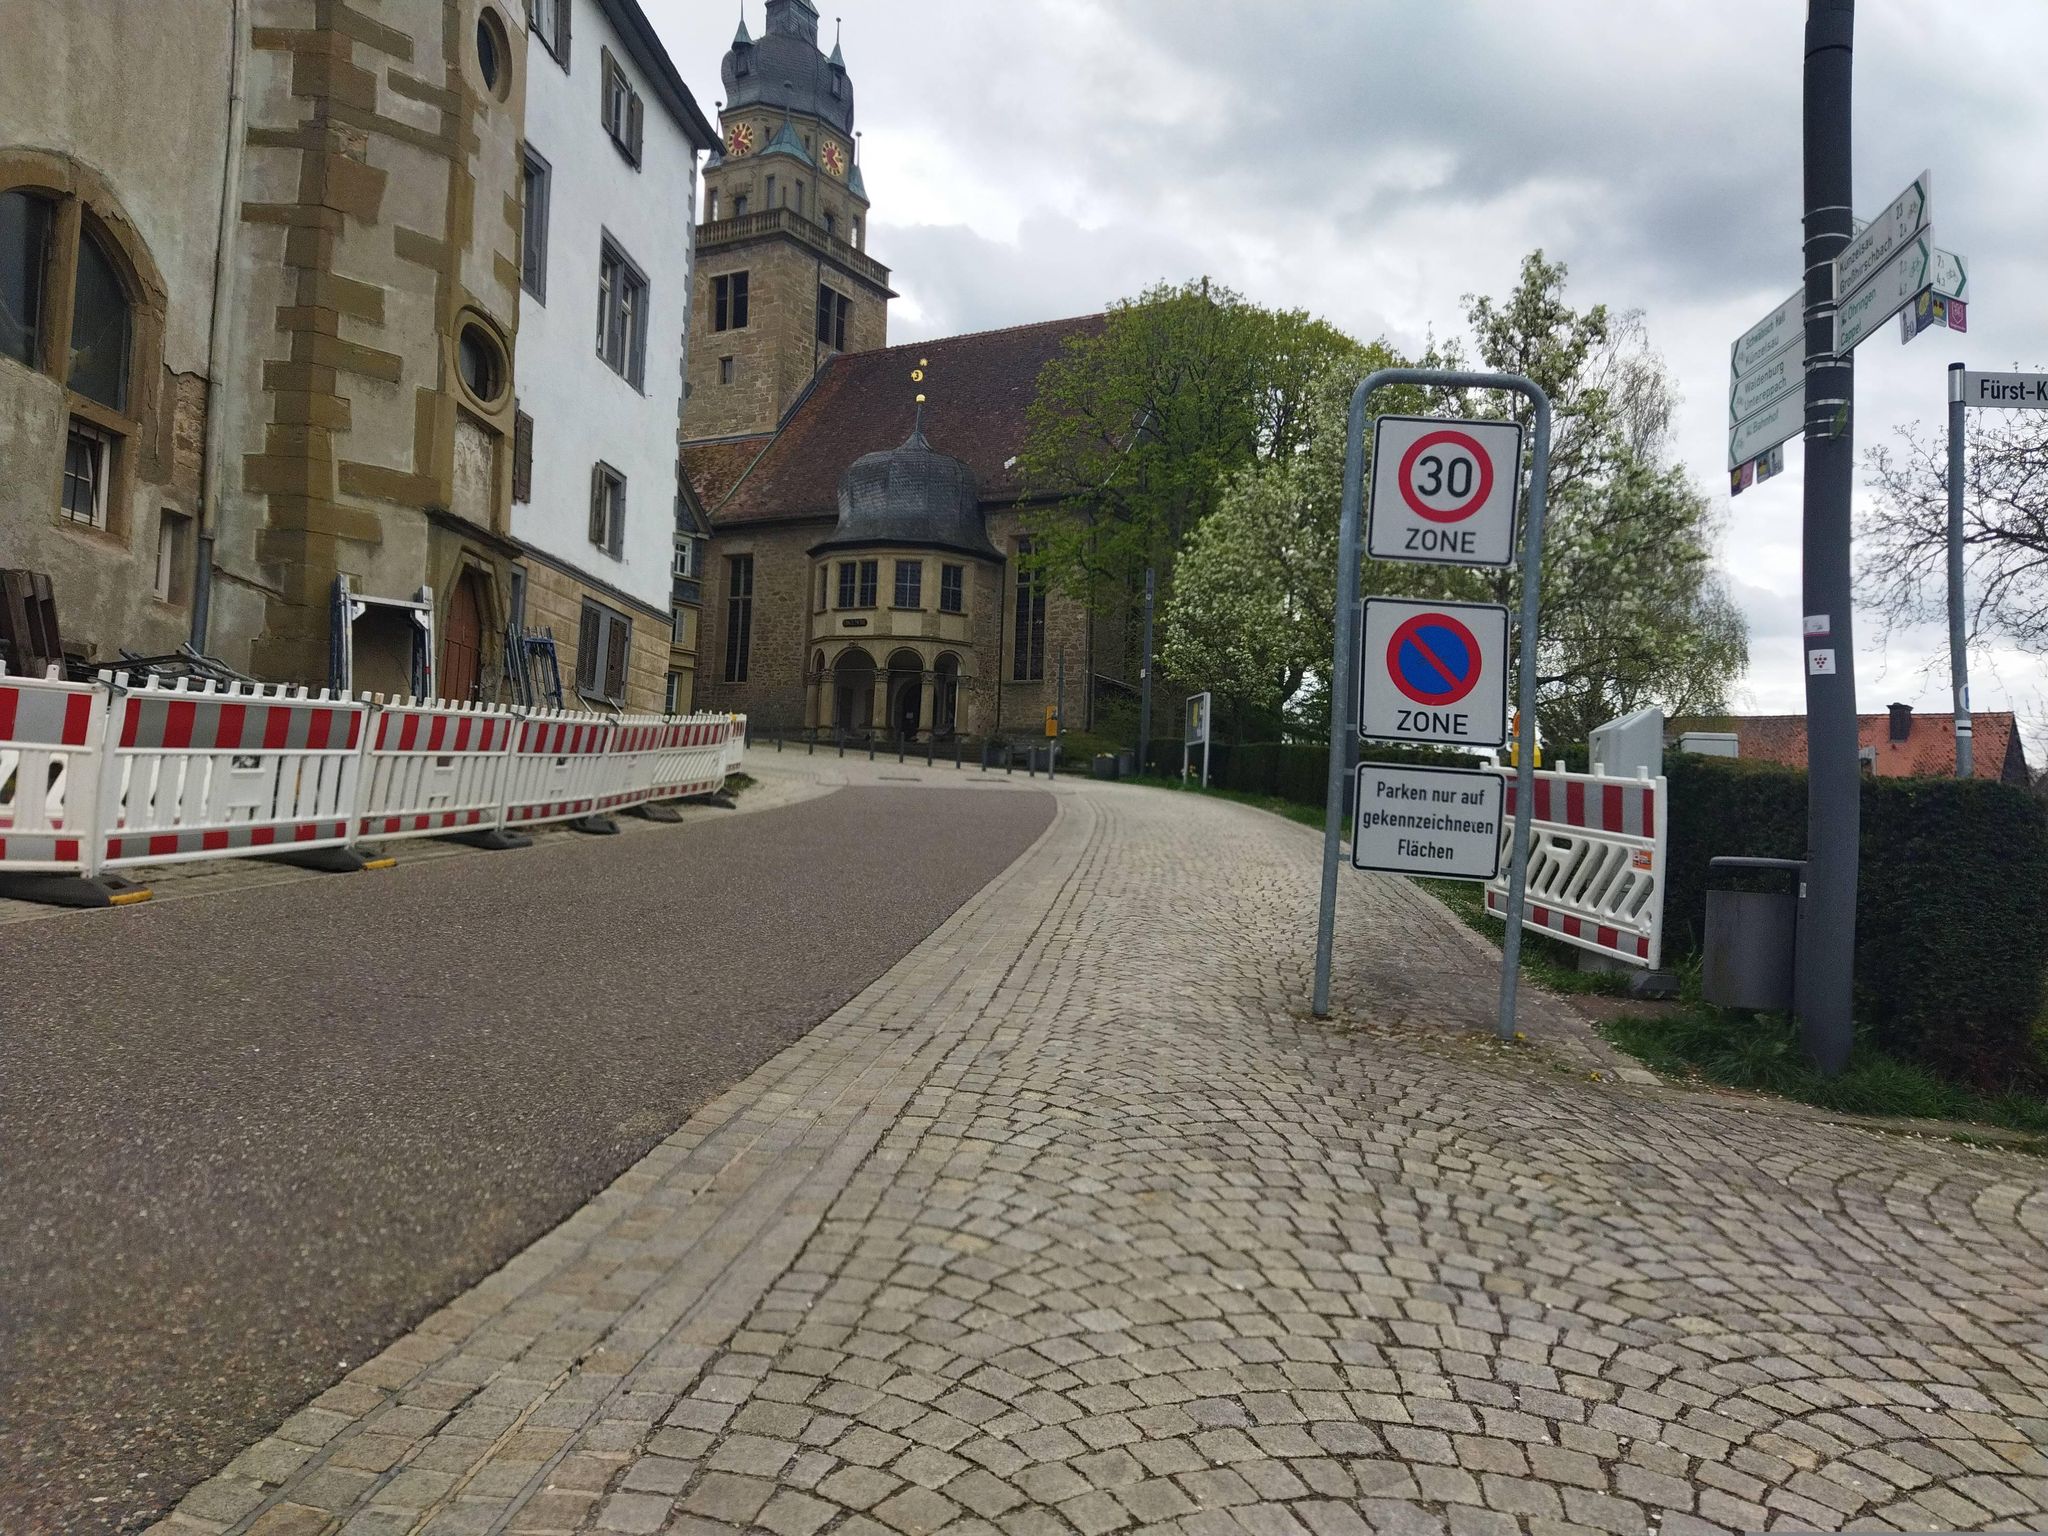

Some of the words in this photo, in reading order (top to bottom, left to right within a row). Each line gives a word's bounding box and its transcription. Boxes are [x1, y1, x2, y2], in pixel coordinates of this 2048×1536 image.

[1745, 361, 1784, 393] Waldenburg
[1745, 376, 1787, 411] Untereppach
[1417, 455, 1473, 498] 30
[1405, 527, 1477, 554] ZONE
[1397, 709, 1469, 736] ZONE
[1377, 781, 1427, 801] Parken
[1432, 790, 1457, 803] nur
[1461, 789, 1485, 805] auf
[1363, 809, 1494, 834] gekennzeichneten
[1398, 838, 1454, 860] Flächen
